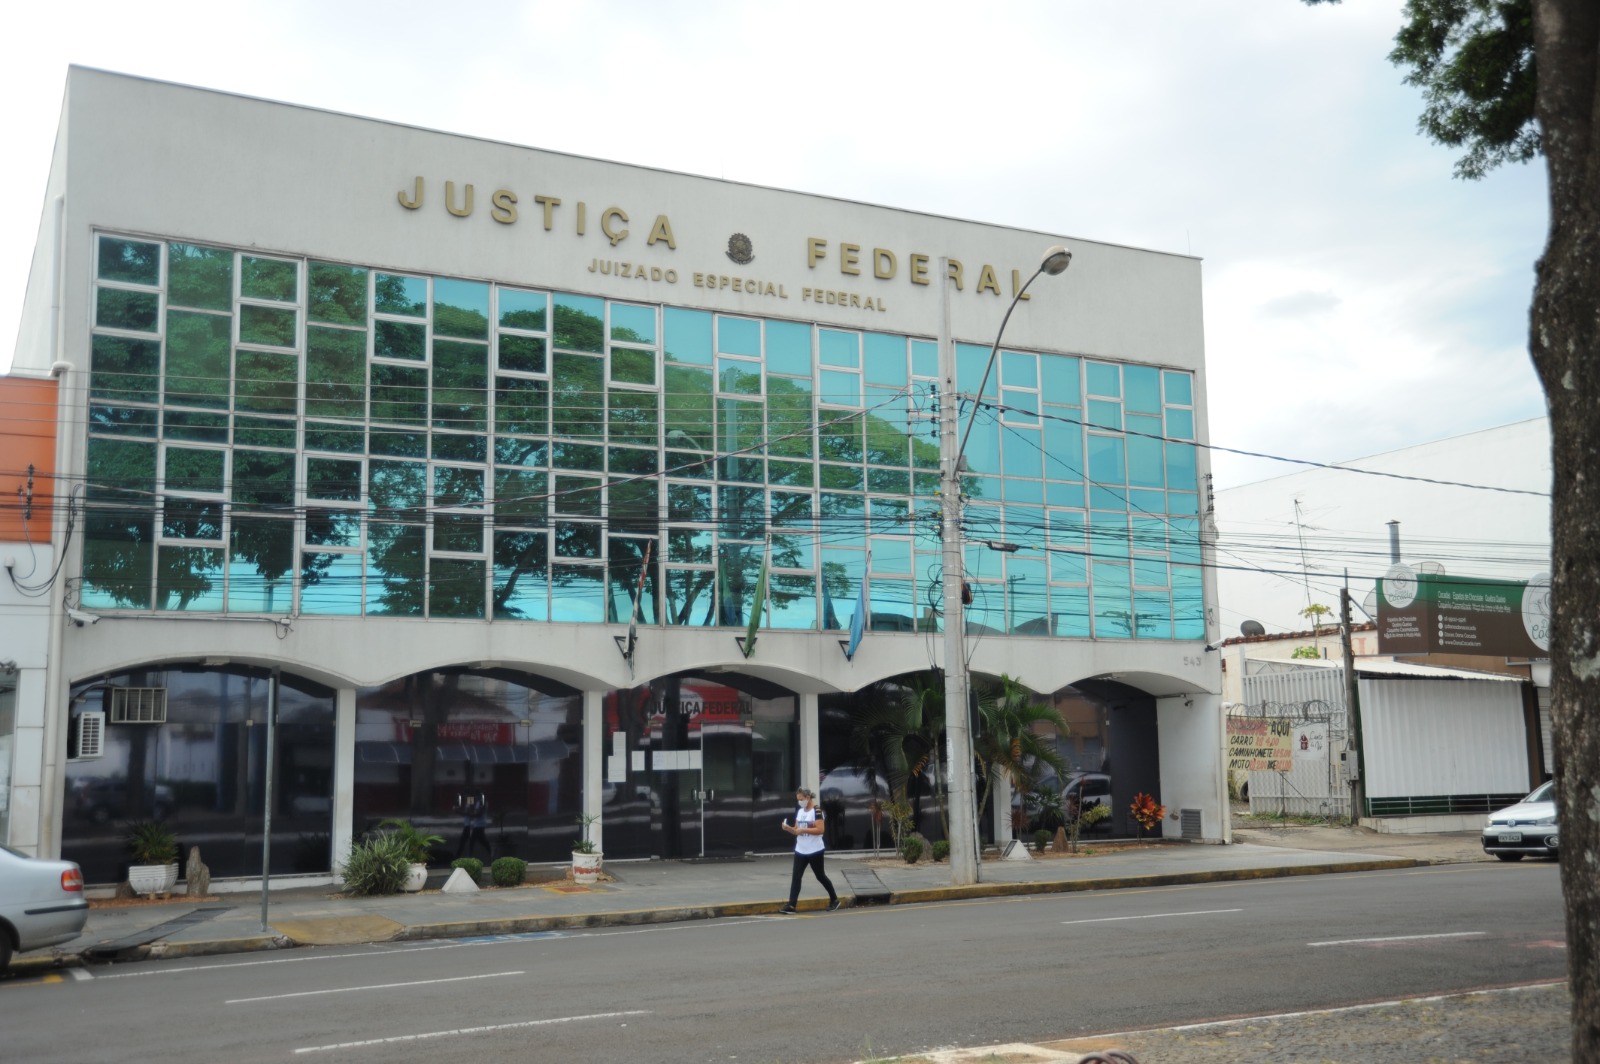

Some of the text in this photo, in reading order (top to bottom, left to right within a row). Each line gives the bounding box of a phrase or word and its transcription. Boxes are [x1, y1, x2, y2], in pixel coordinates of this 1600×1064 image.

[398, 175, 1031, 301] JUSTIÇA FEDERAL
[588, 257, 888, 312] JUIZADO ESPECIAL FEDERAL
[1183, 656, 1202, 666] 543
[1270, 720, 1290, 737] AQUI
[1230, 735, 1254, 746] CARRO
[1228, 747, 1273, 758] CAMINHONETE
[1229, 759, 1250, 769] MOTO
